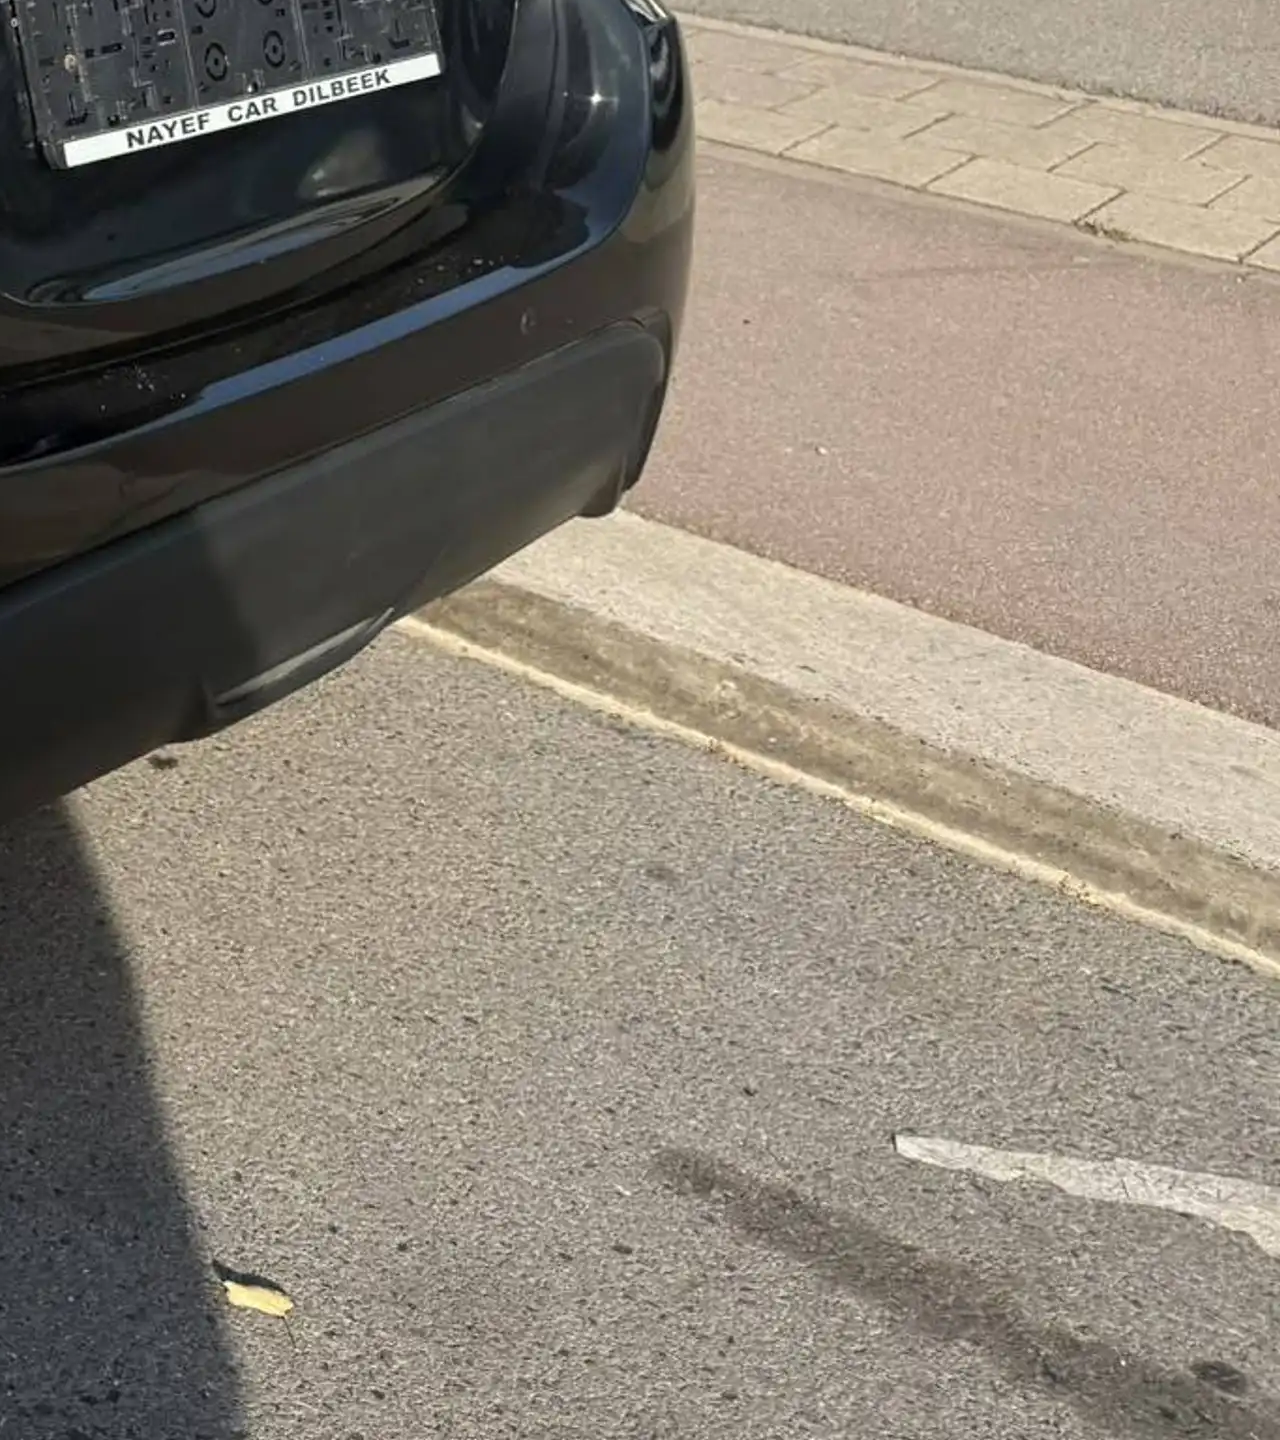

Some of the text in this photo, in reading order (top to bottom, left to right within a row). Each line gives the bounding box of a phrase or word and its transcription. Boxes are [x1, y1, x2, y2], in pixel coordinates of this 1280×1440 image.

[126, 69, 391, 149] NAYEF CAR DILBEEK
